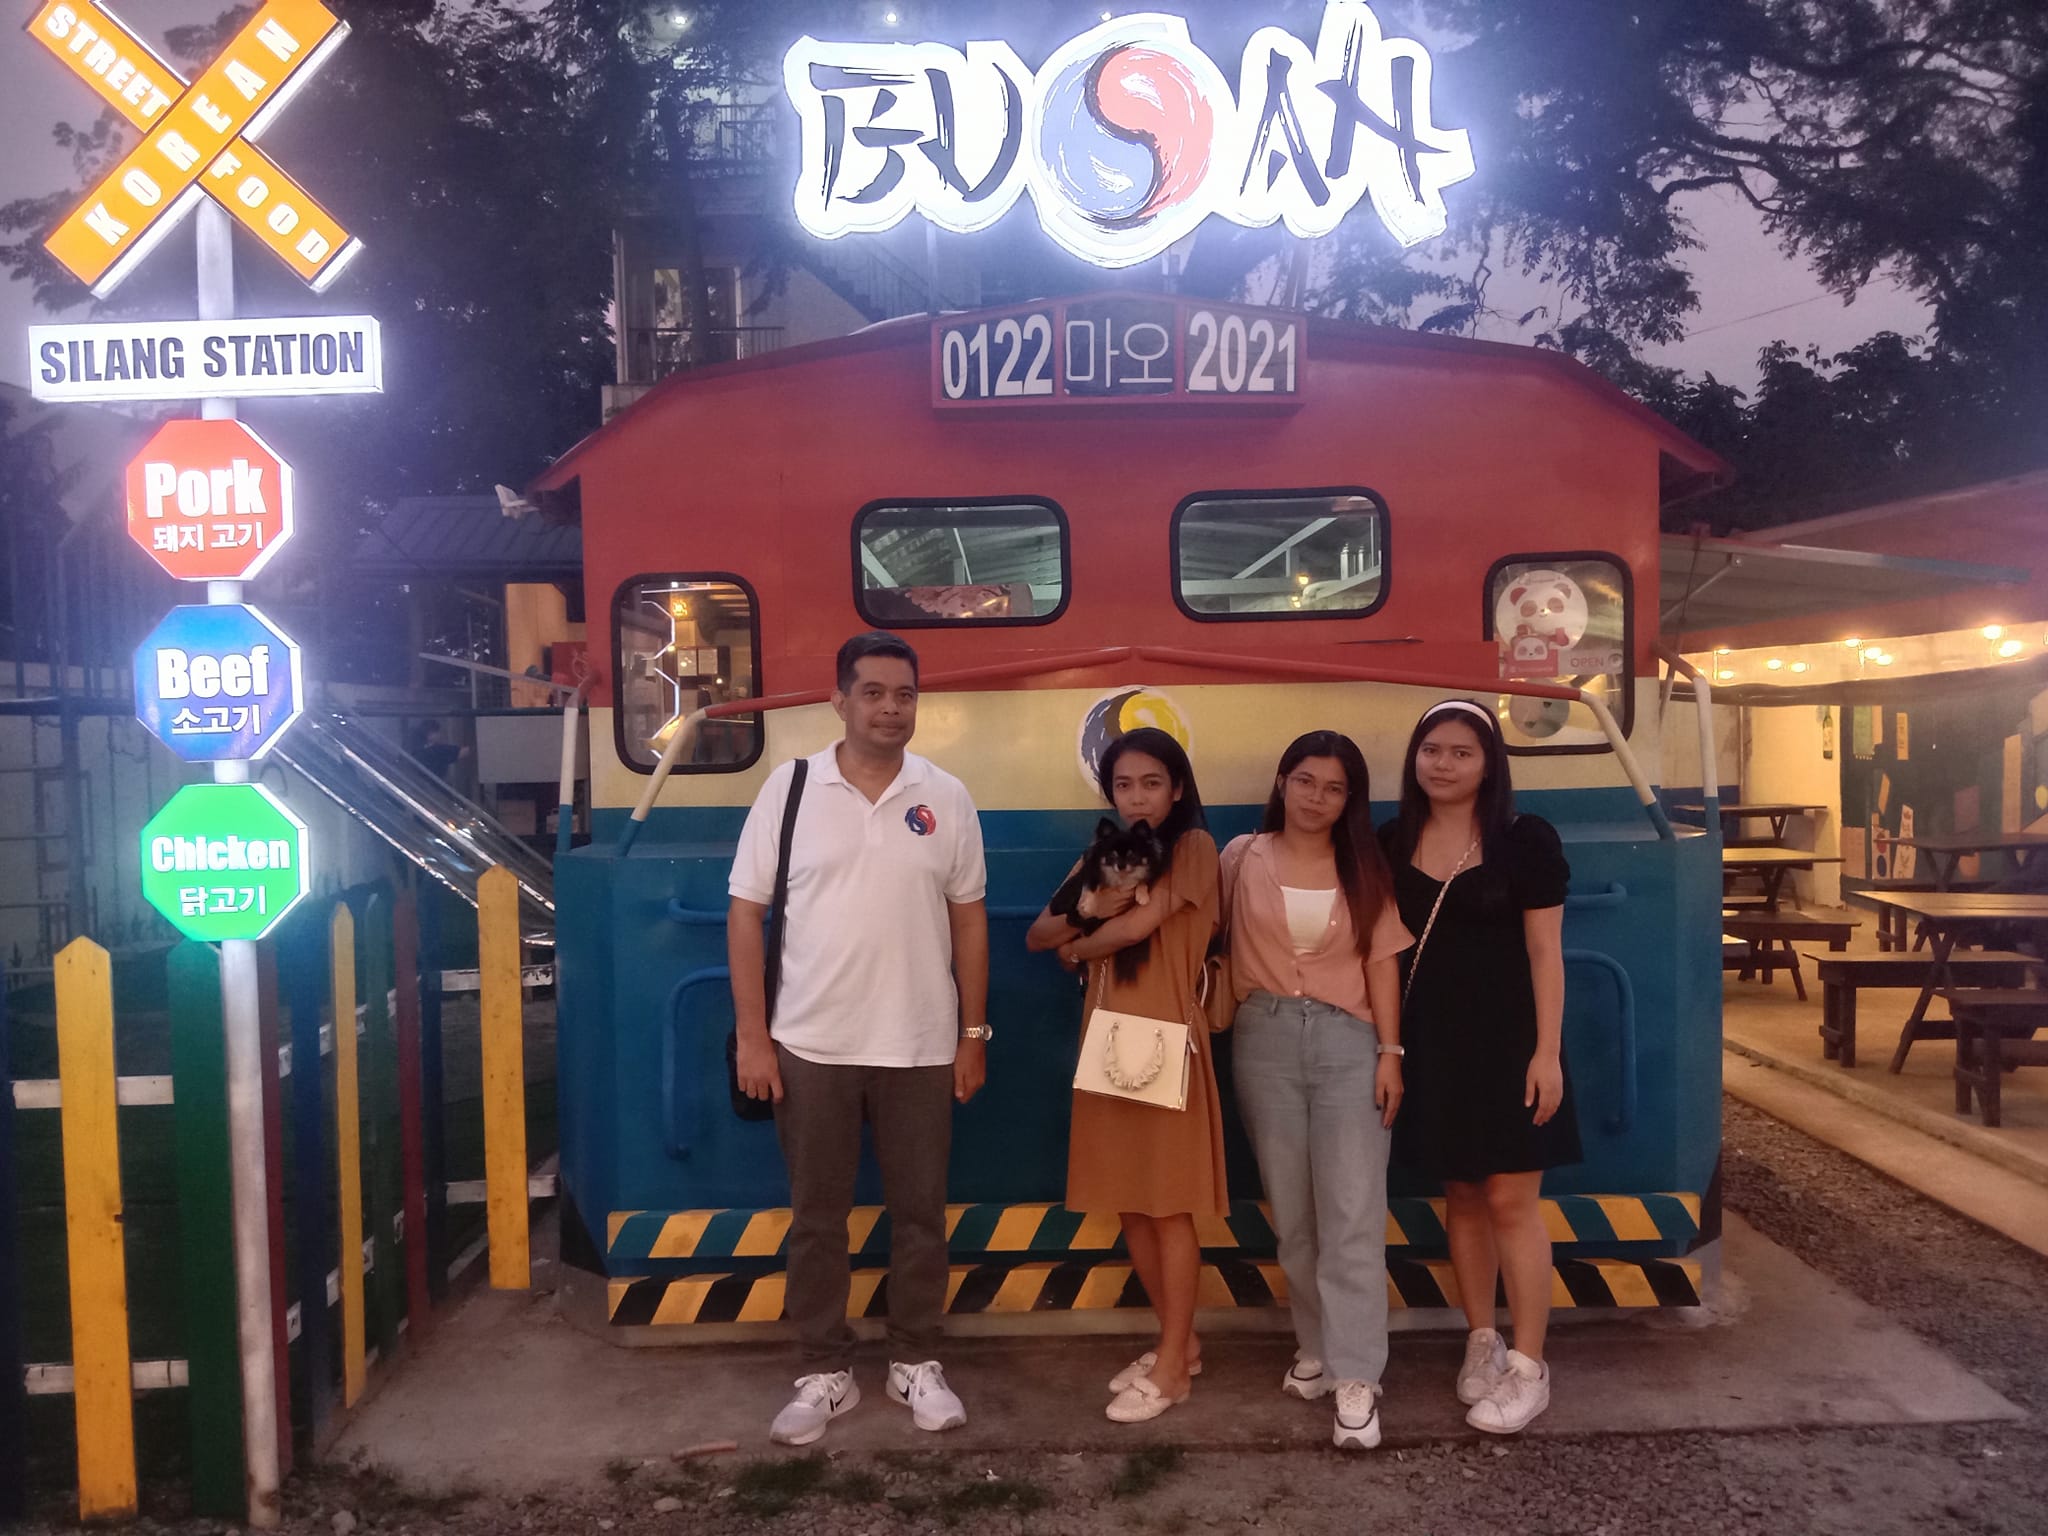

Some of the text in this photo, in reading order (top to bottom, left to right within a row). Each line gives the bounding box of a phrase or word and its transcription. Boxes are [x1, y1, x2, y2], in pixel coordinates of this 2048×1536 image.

[45, 5, 172, 119] STREET
[83, 18, 301, 247] KOREAN
[209, 150, 331, 264] FOOD
[40, 331, 364, 384] SILANG STATION
[942, 311, 1296, 399] 0122 마오 2021
[144, 458, 267, 518] Pork
[153, 521, 263, 552] 돼지 고기
[156, 645, 269, 700] Beef
[171, 704, 261, 735] 소고기
[151, 835, 291, 872] Chicken
[179, 885, 267, 917] 닭고기
